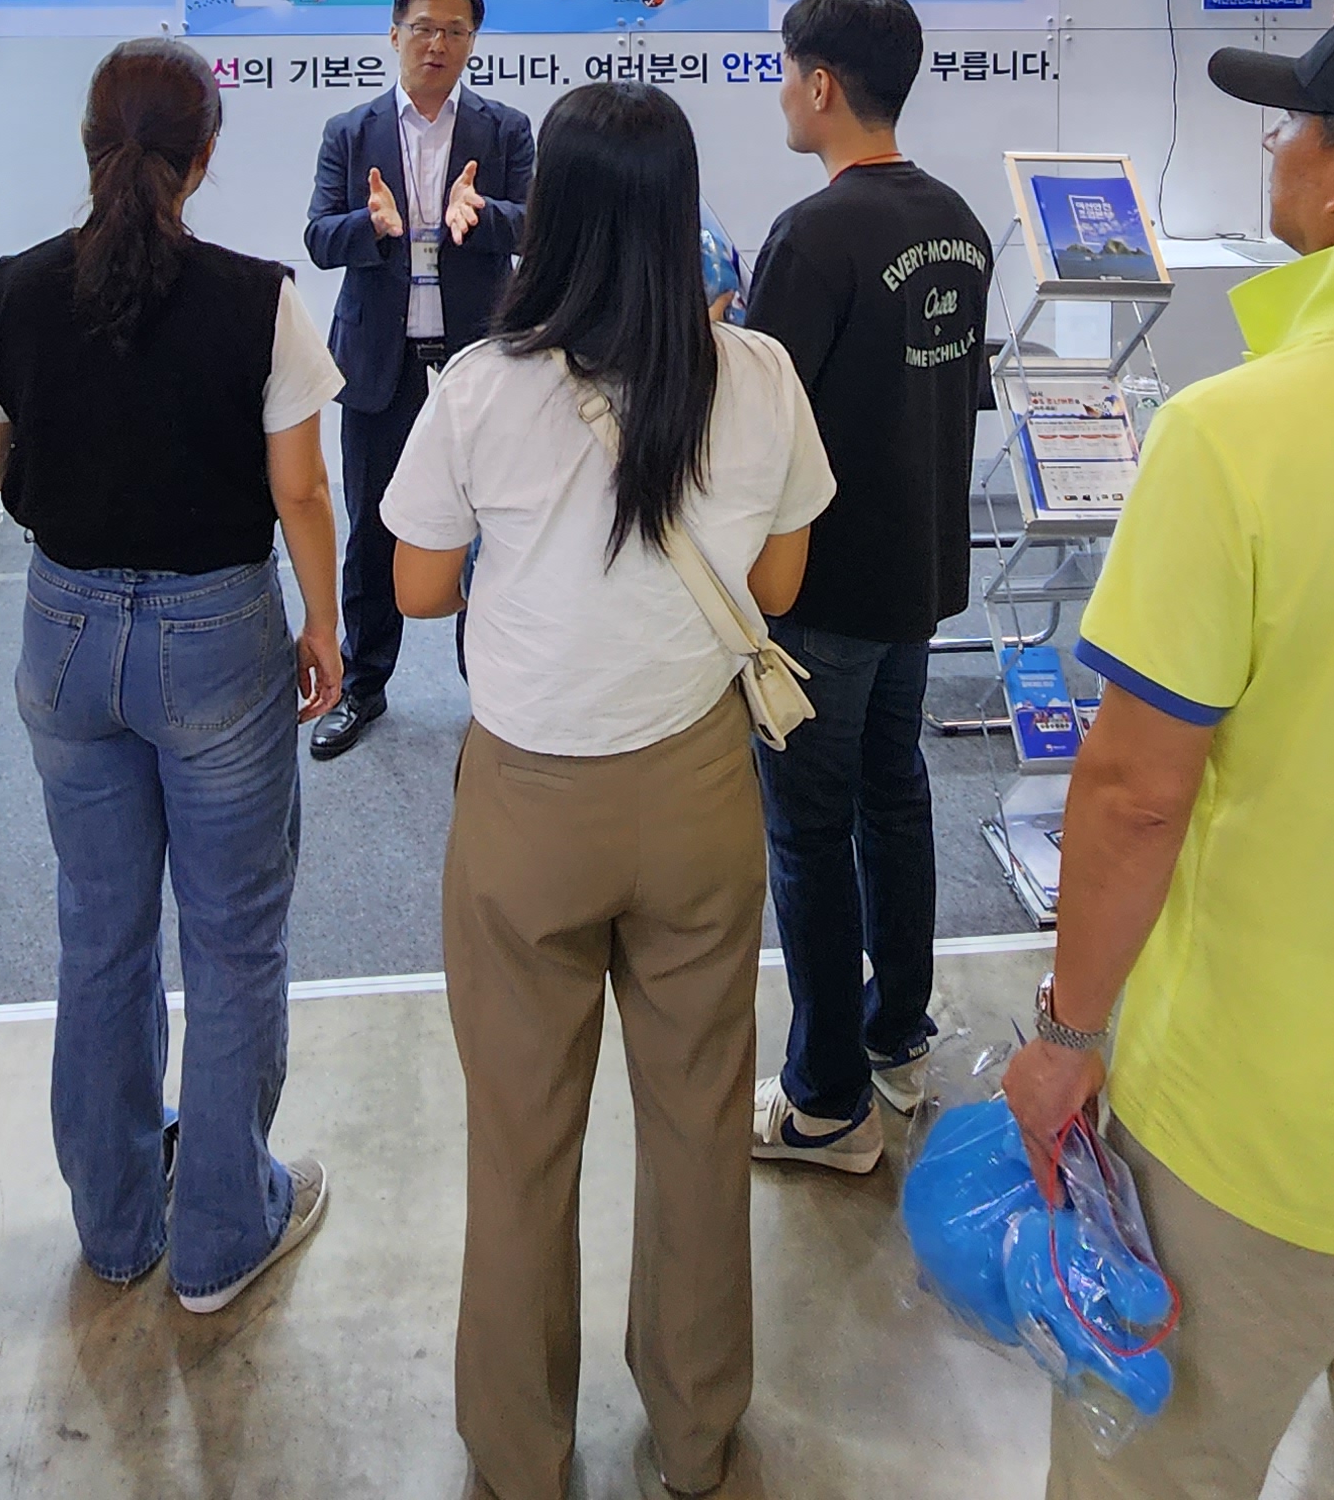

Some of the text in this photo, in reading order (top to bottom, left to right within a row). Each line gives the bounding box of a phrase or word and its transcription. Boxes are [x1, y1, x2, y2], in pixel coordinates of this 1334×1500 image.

[289, 55, 386, 88] 기본은
[583, 52, 709, 85] 여러분의
[929, 50, 1060, 82] 부릅니다.
[881, 238, 987, 292] EVERY-MOMENT
